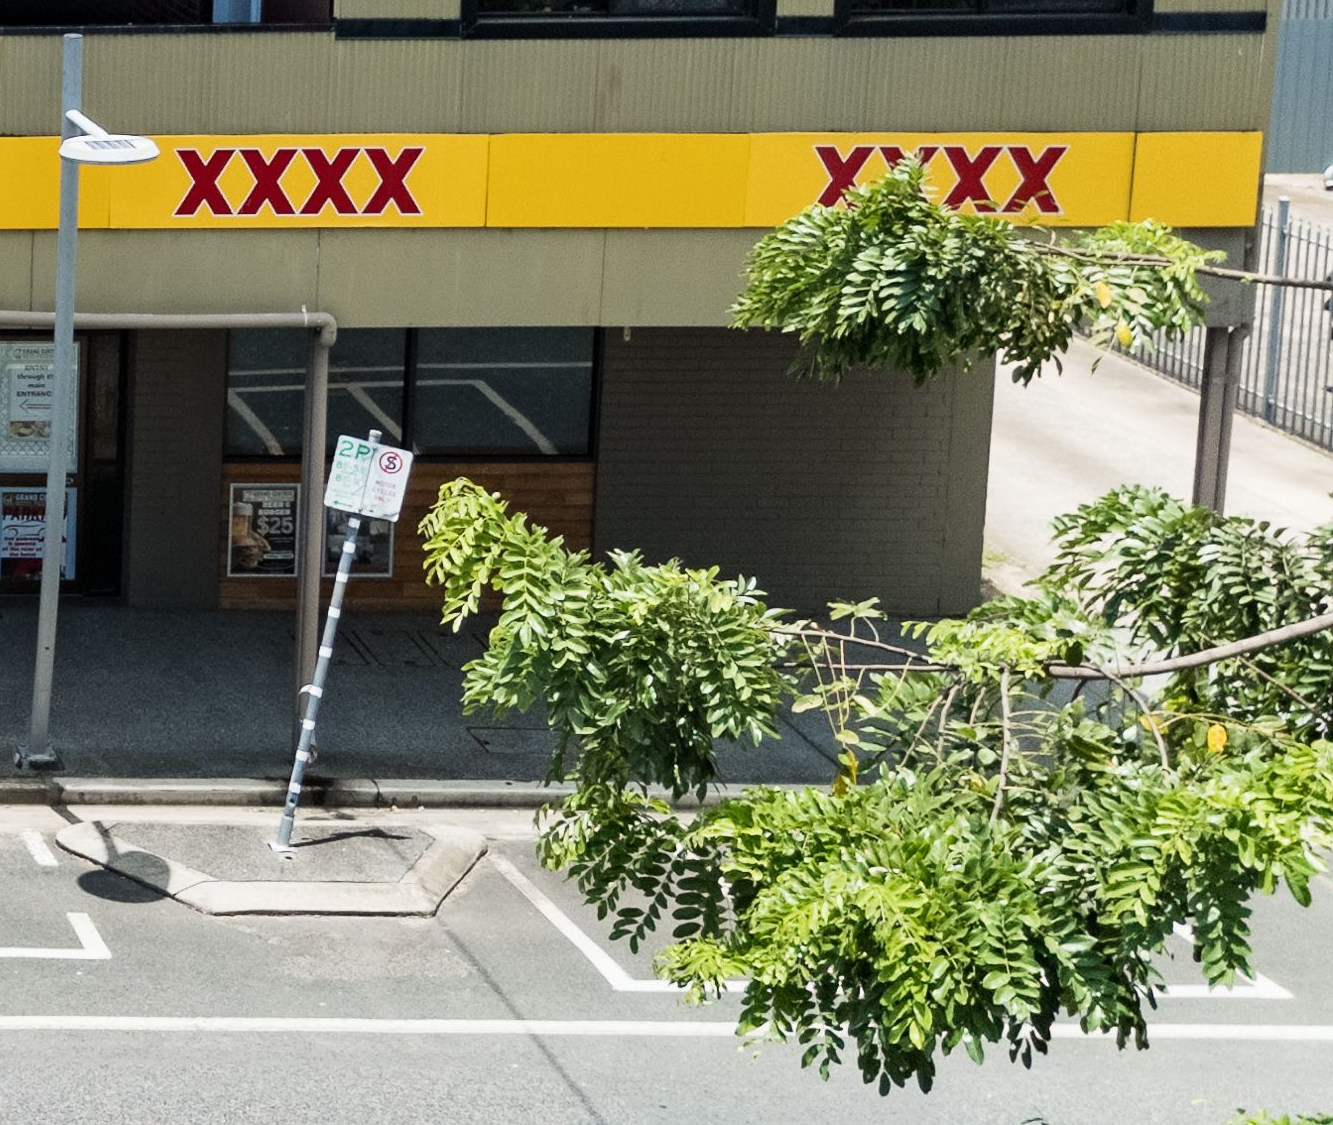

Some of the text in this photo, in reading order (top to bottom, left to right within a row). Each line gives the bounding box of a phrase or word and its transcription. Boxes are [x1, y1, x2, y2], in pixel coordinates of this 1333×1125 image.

[174, 147, 425, 216] XXXX
[17, 373, 45, 381] through
[338, 440, 371, 459] 2P
[256, 516, 294, 536] $25
